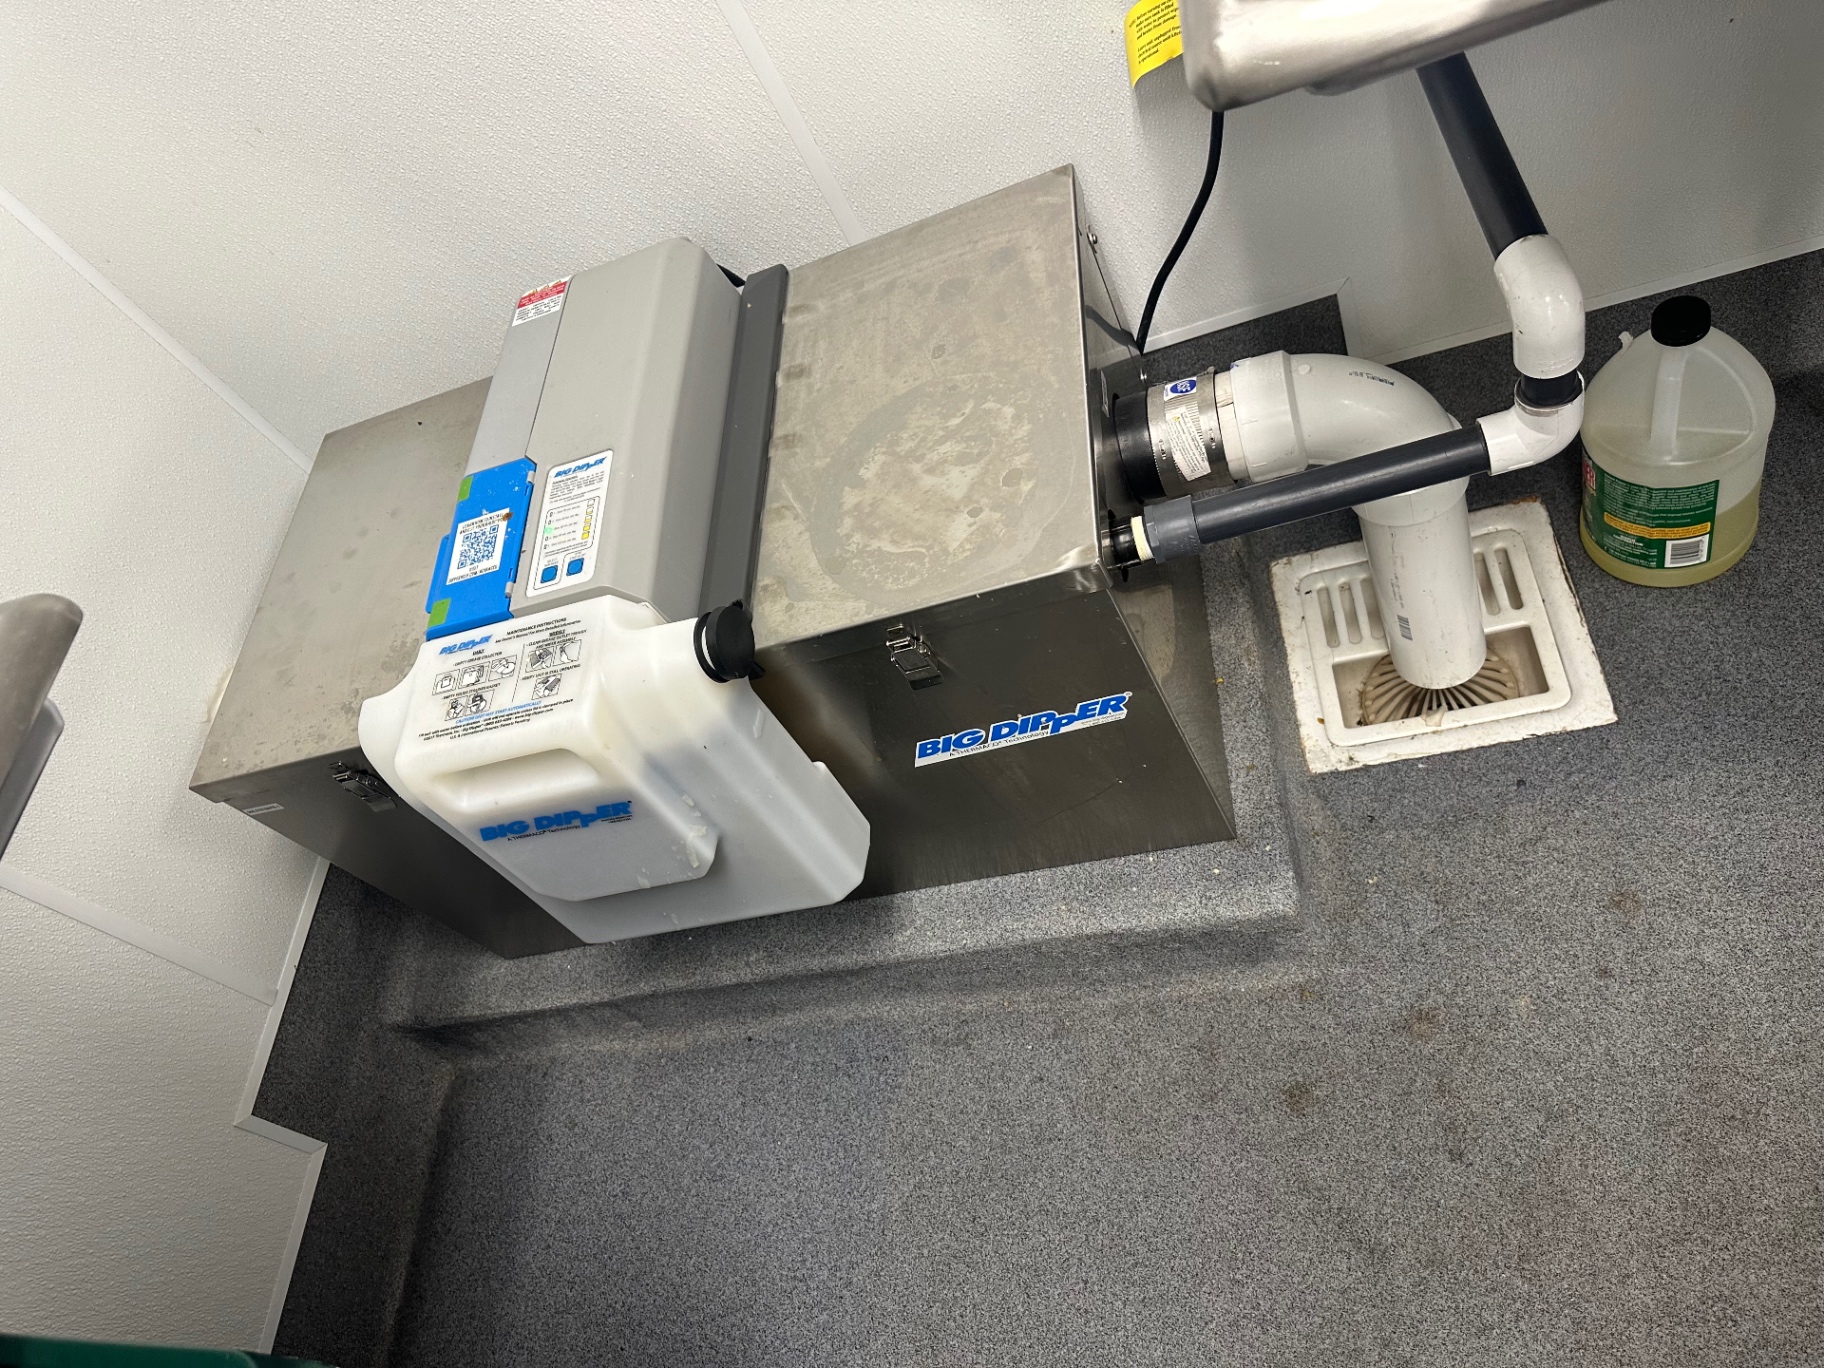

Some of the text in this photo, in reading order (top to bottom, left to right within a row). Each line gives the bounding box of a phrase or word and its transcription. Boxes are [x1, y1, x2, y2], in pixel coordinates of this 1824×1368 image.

[554, 456, 607, 478] BIG DIPPER
[439, 635, 492, 655] BIG DIPPER
[918, 694, 1127, 759] BIG DIPPER
[1004, 730, 1049, 744] Technology
[479, 801, 632, 842] BIG DIPPER
